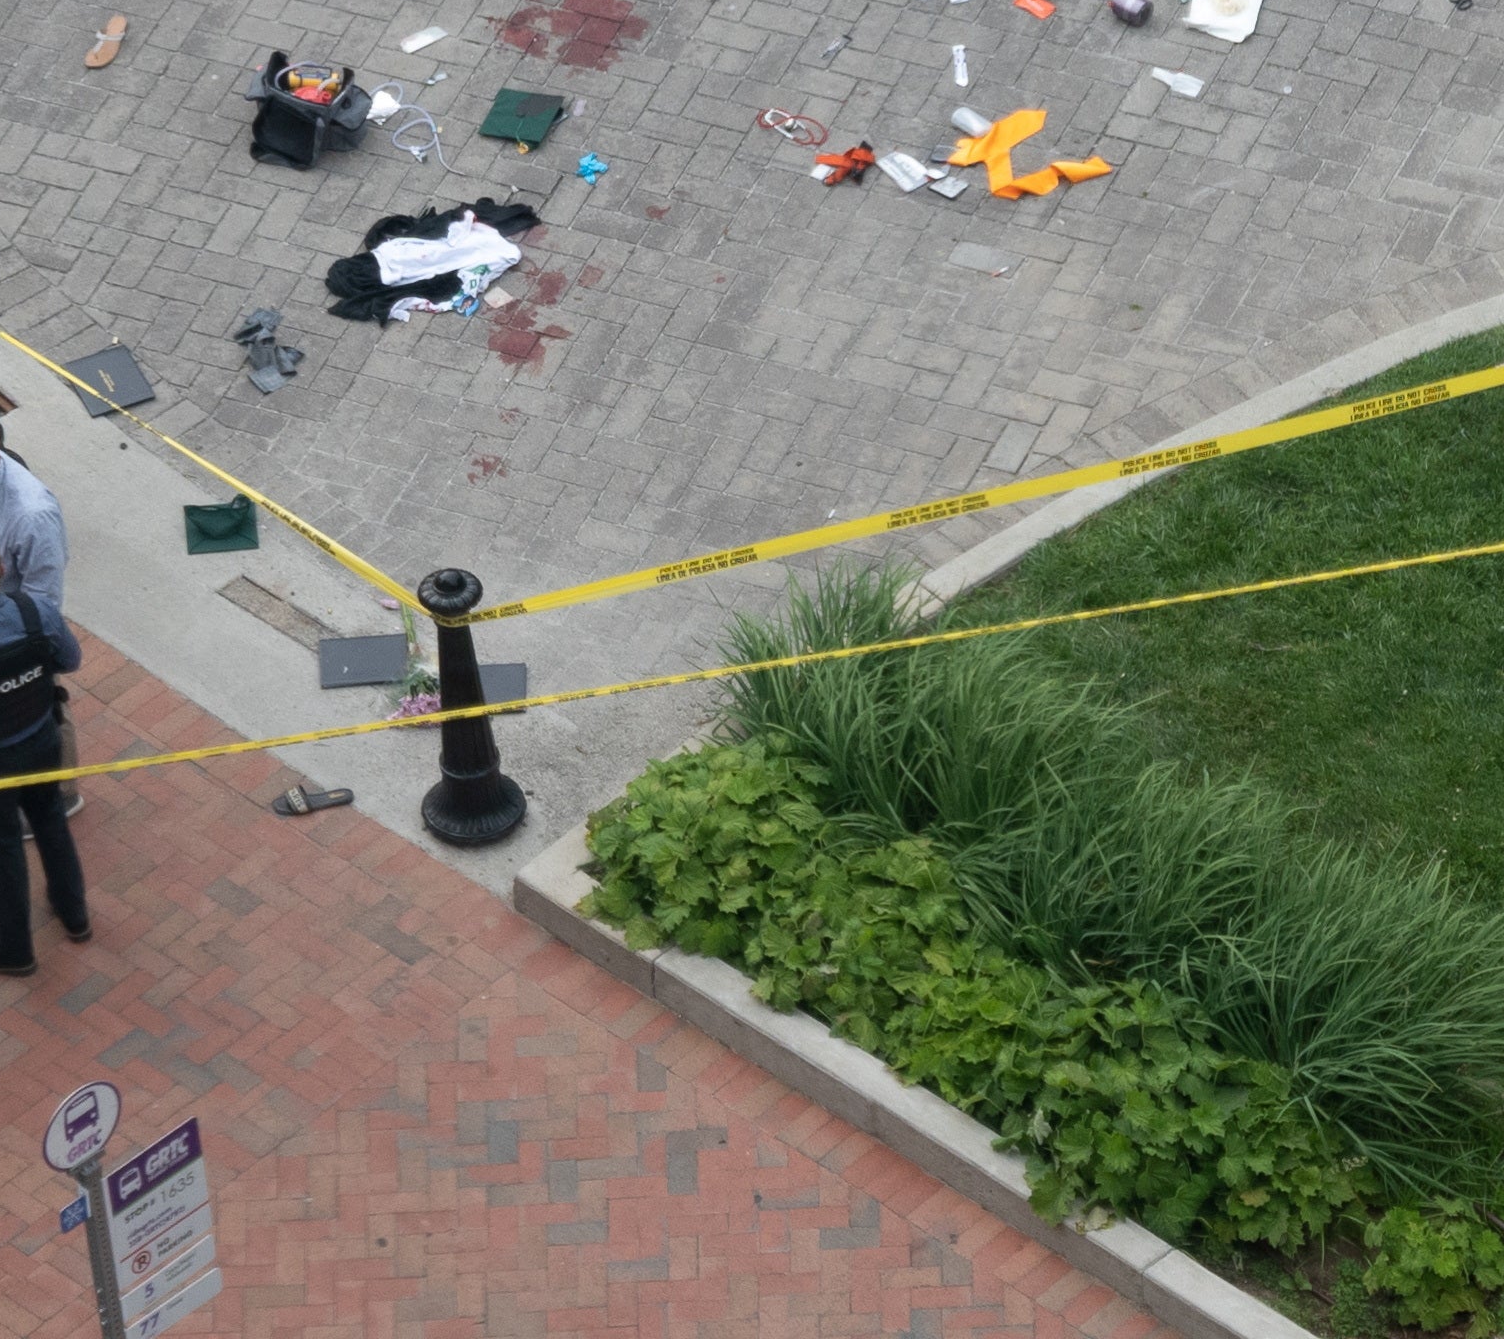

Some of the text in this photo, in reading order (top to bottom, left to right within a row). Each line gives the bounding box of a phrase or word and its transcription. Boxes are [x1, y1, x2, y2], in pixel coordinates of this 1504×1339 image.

[66, 1129, 102, 1163] GRTC
[145, 1131, 190, 1175] GRTC
[160, 1171, 195, 1202] 1635
[156, 1237, 170, 1249] NO
[158, 1230, 193, 1258] PARKING
[144, 1282, 155, 1299] 5
[139, 1311, 160, 1336] 77
